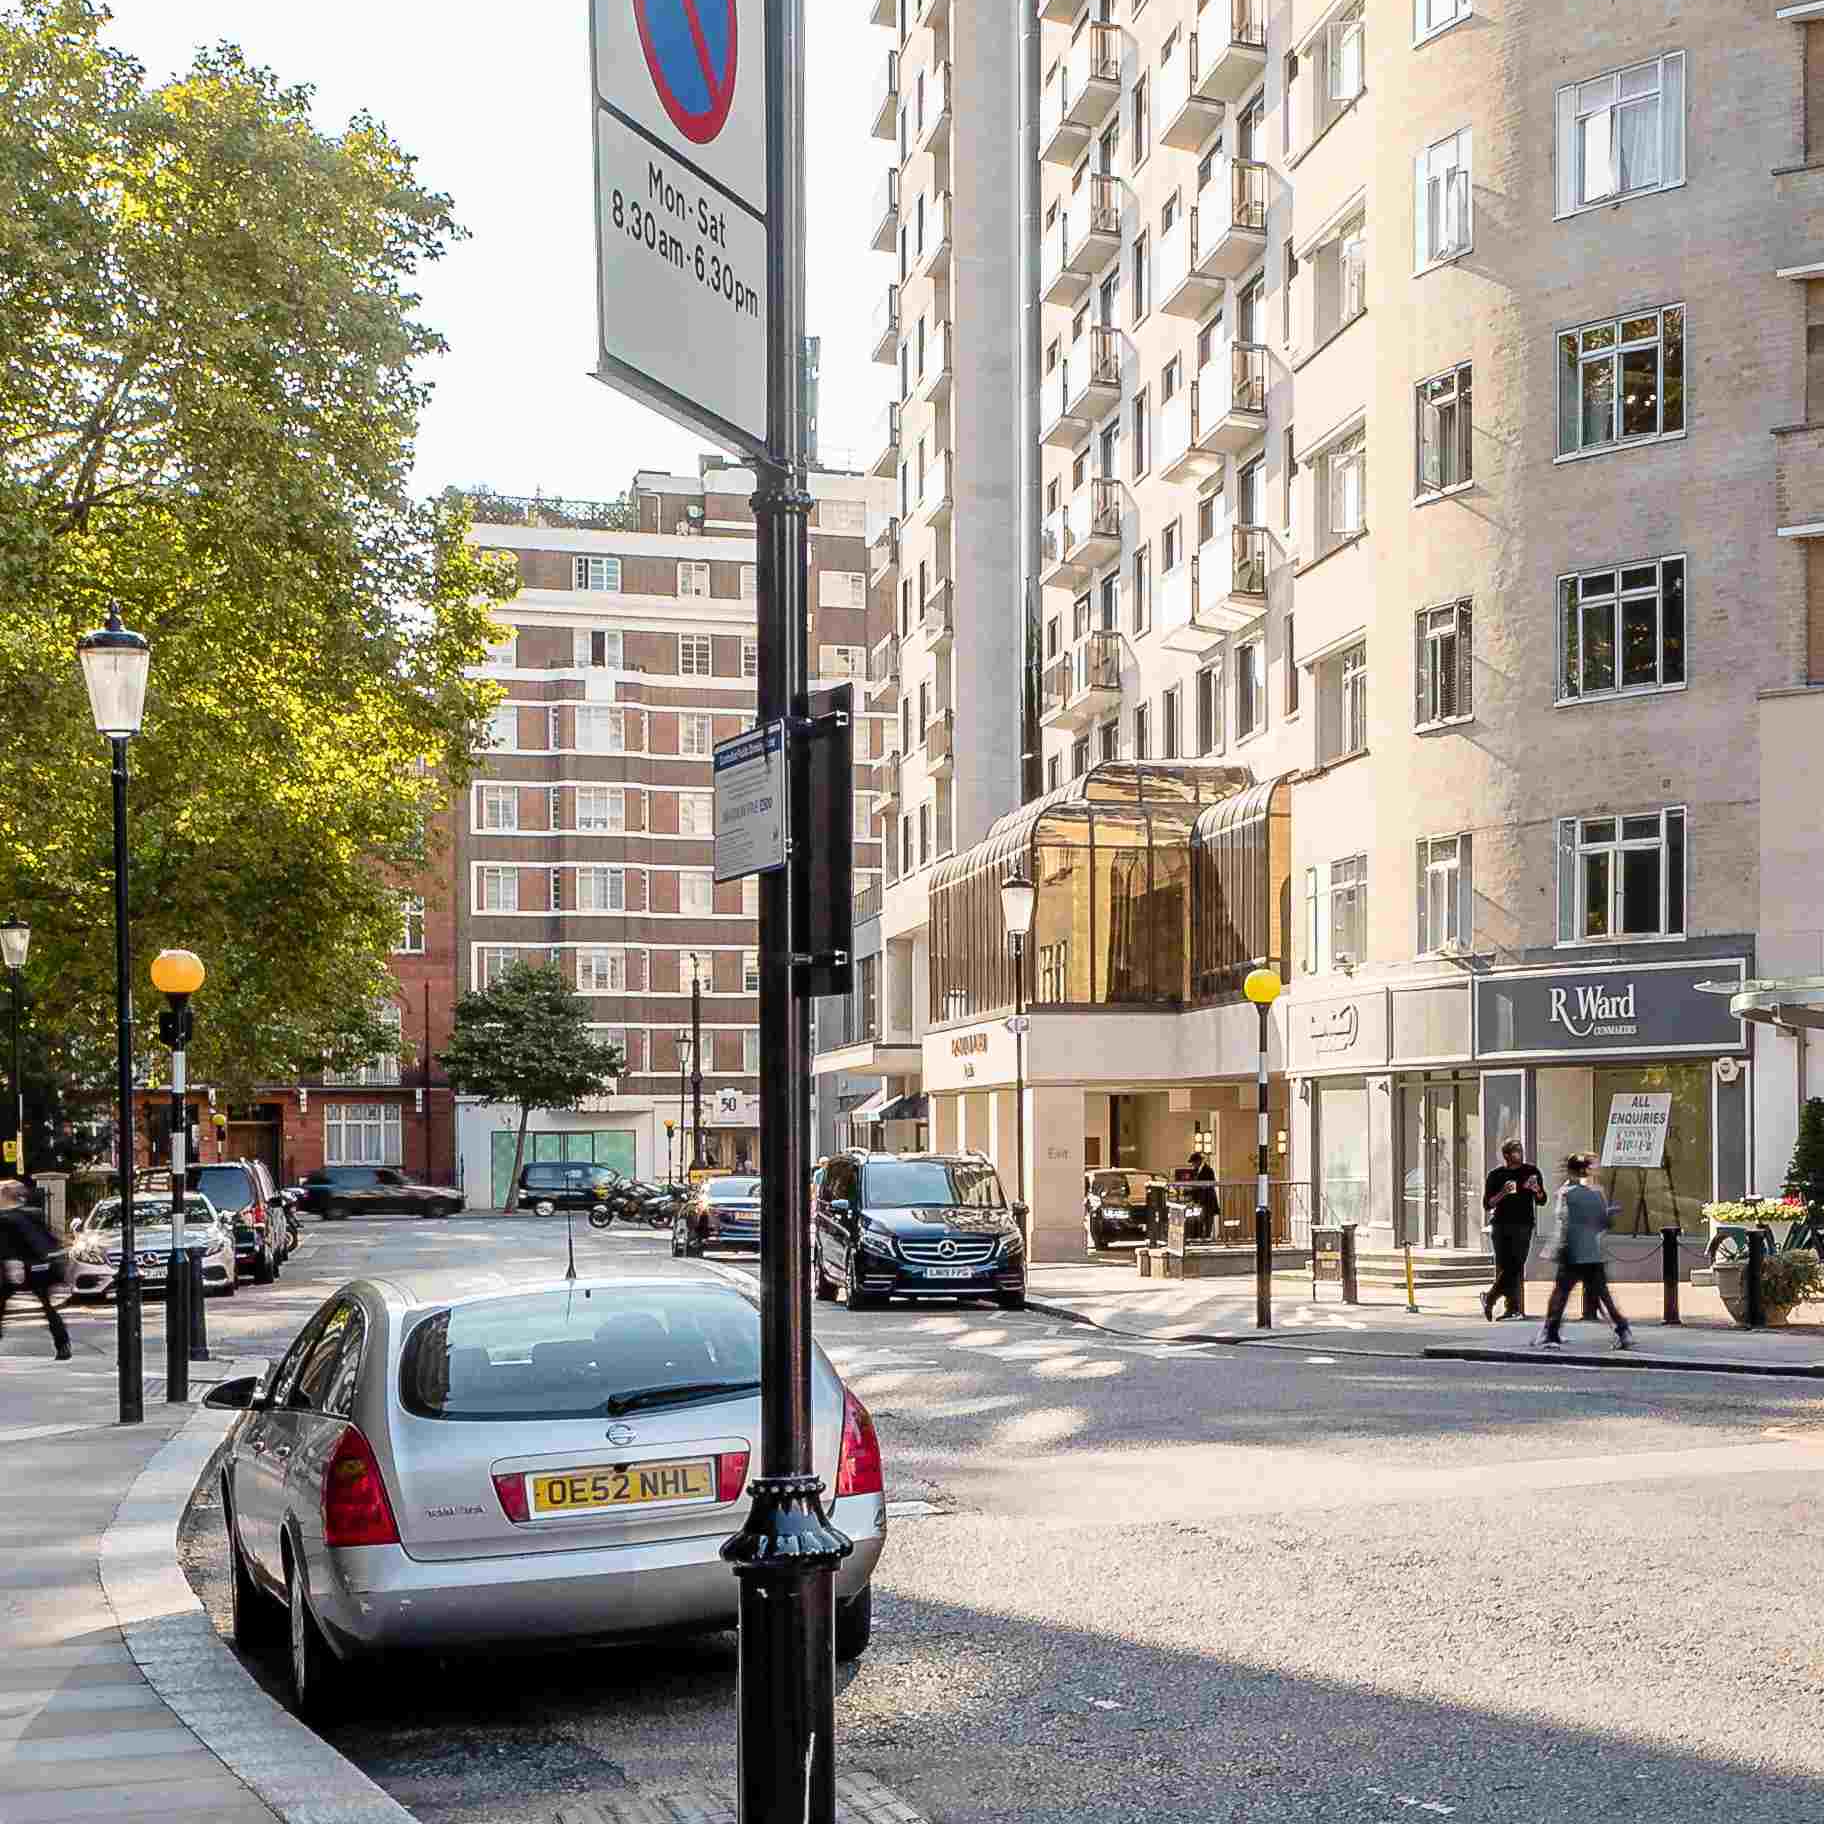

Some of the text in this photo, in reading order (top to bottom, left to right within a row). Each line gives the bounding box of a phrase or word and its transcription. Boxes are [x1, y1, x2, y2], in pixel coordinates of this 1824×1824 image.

[720, 1096, 737, 1113] 50
[1631, 1095, 1651, 1108] ALL
[1610, 1112, 1667, 1125] ENQUIRIES
[549, 1467, 700, 1506] OE52 NHL
